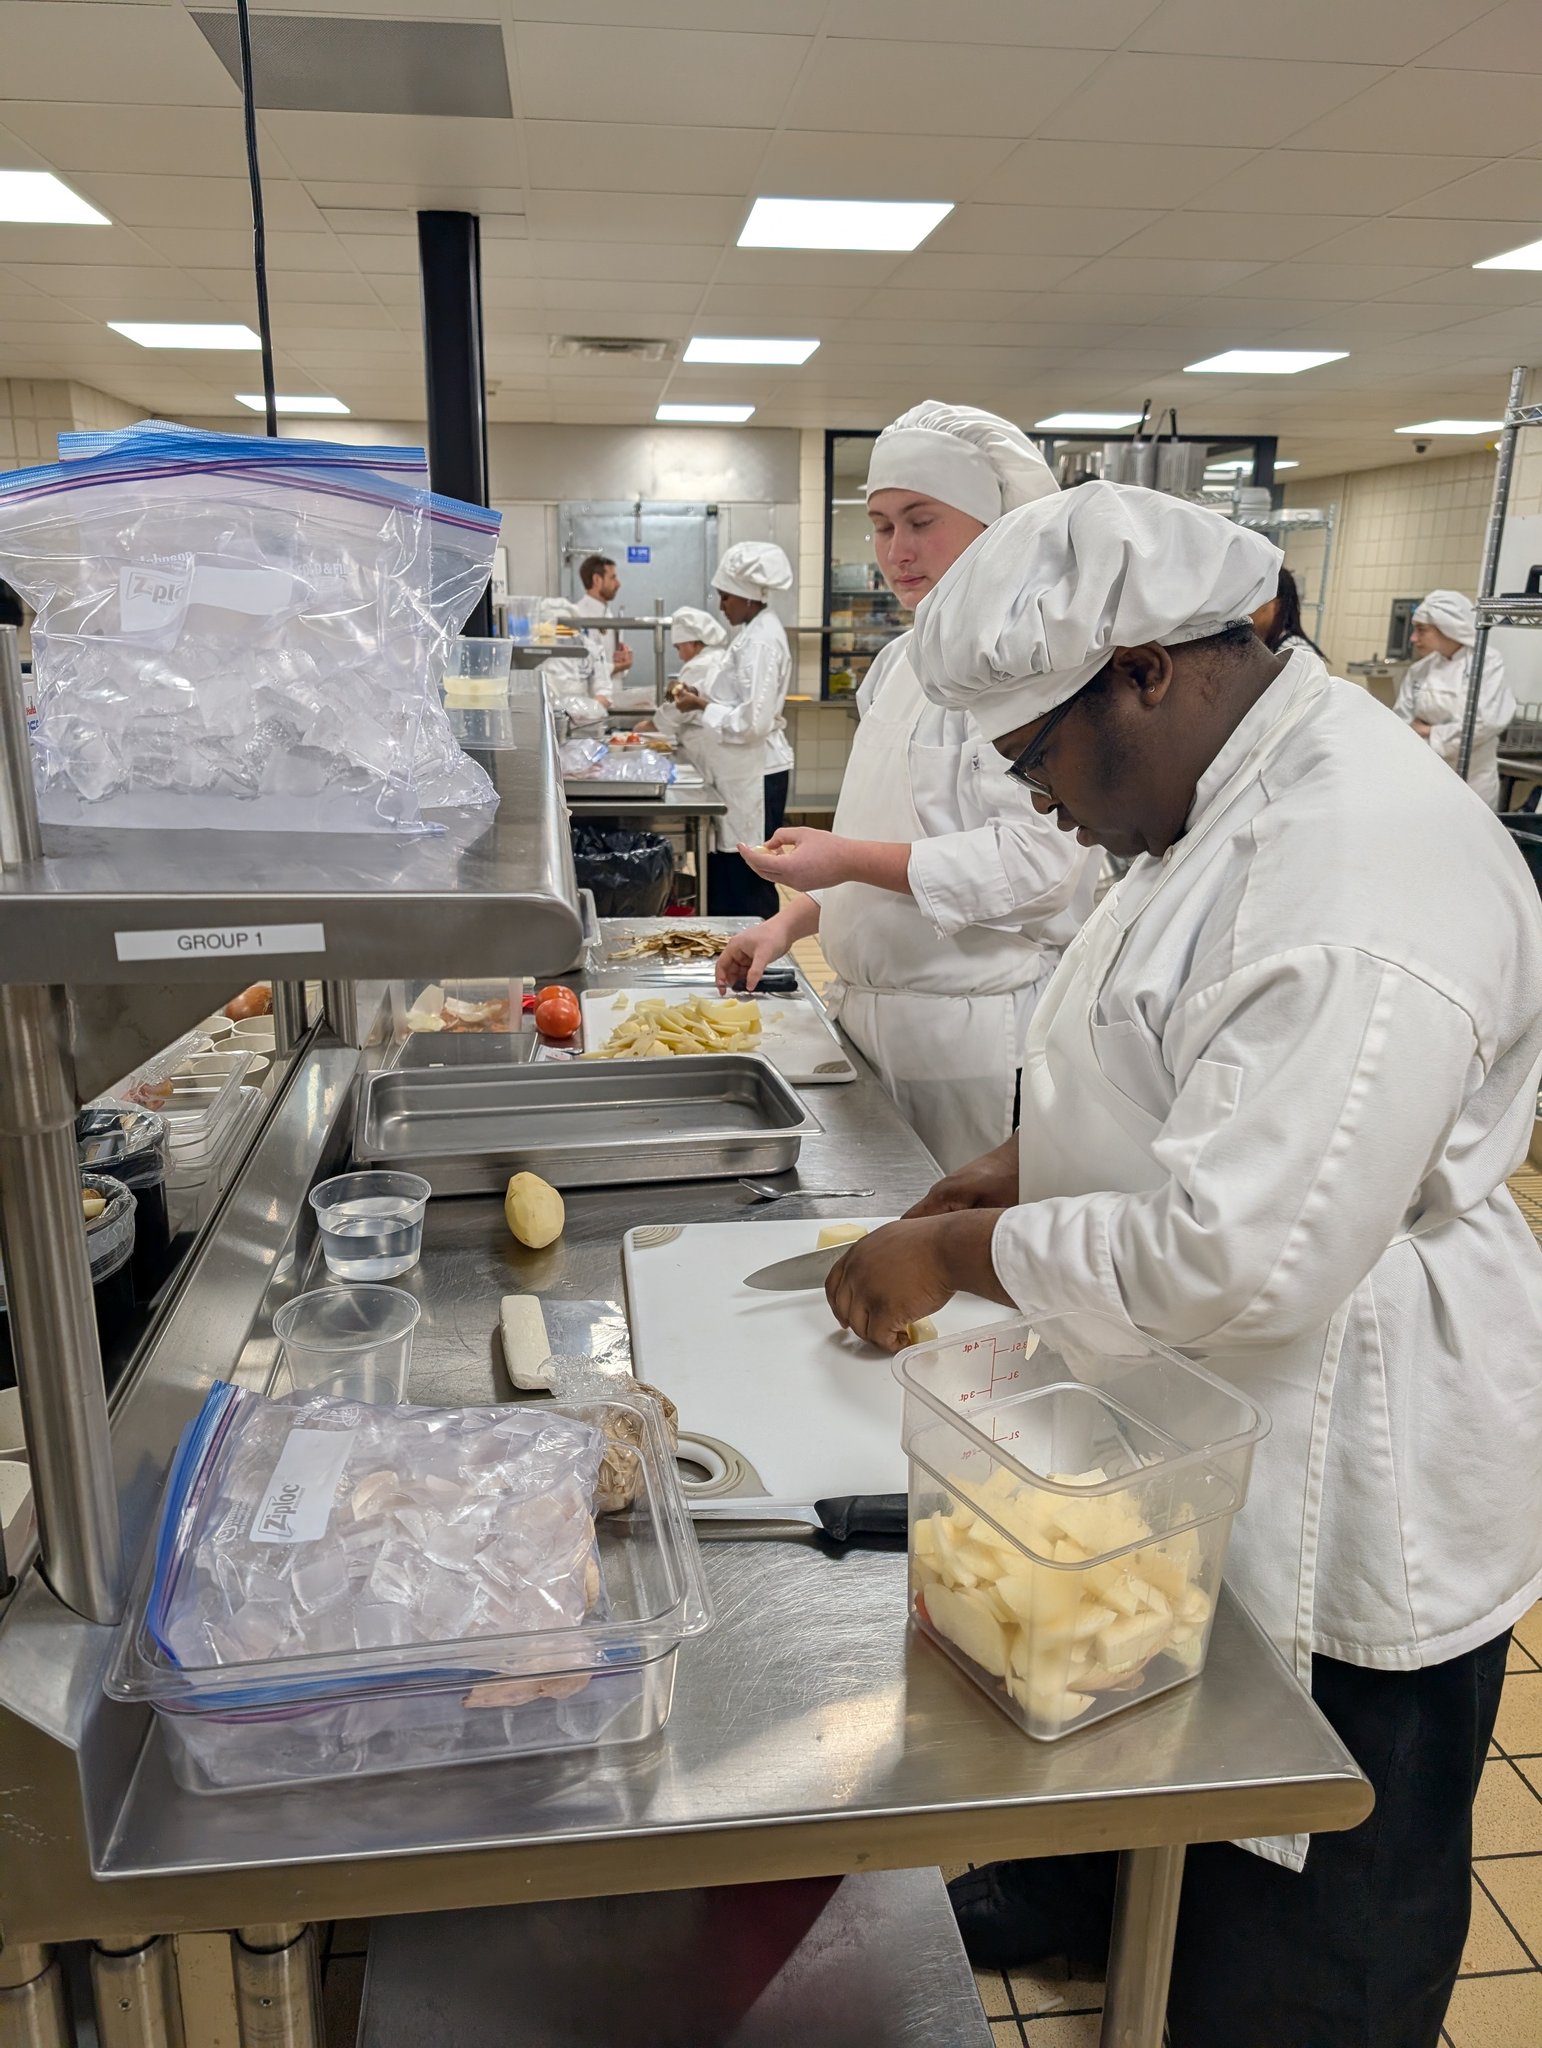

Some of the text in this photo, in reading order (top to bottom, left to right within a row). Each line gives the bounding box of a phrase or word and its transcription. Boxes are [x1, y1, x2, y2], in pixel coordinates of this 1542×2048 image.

[177, 932, 263, 951] GROUP 1
[263, 1484, 300, 1531] Ziploc
